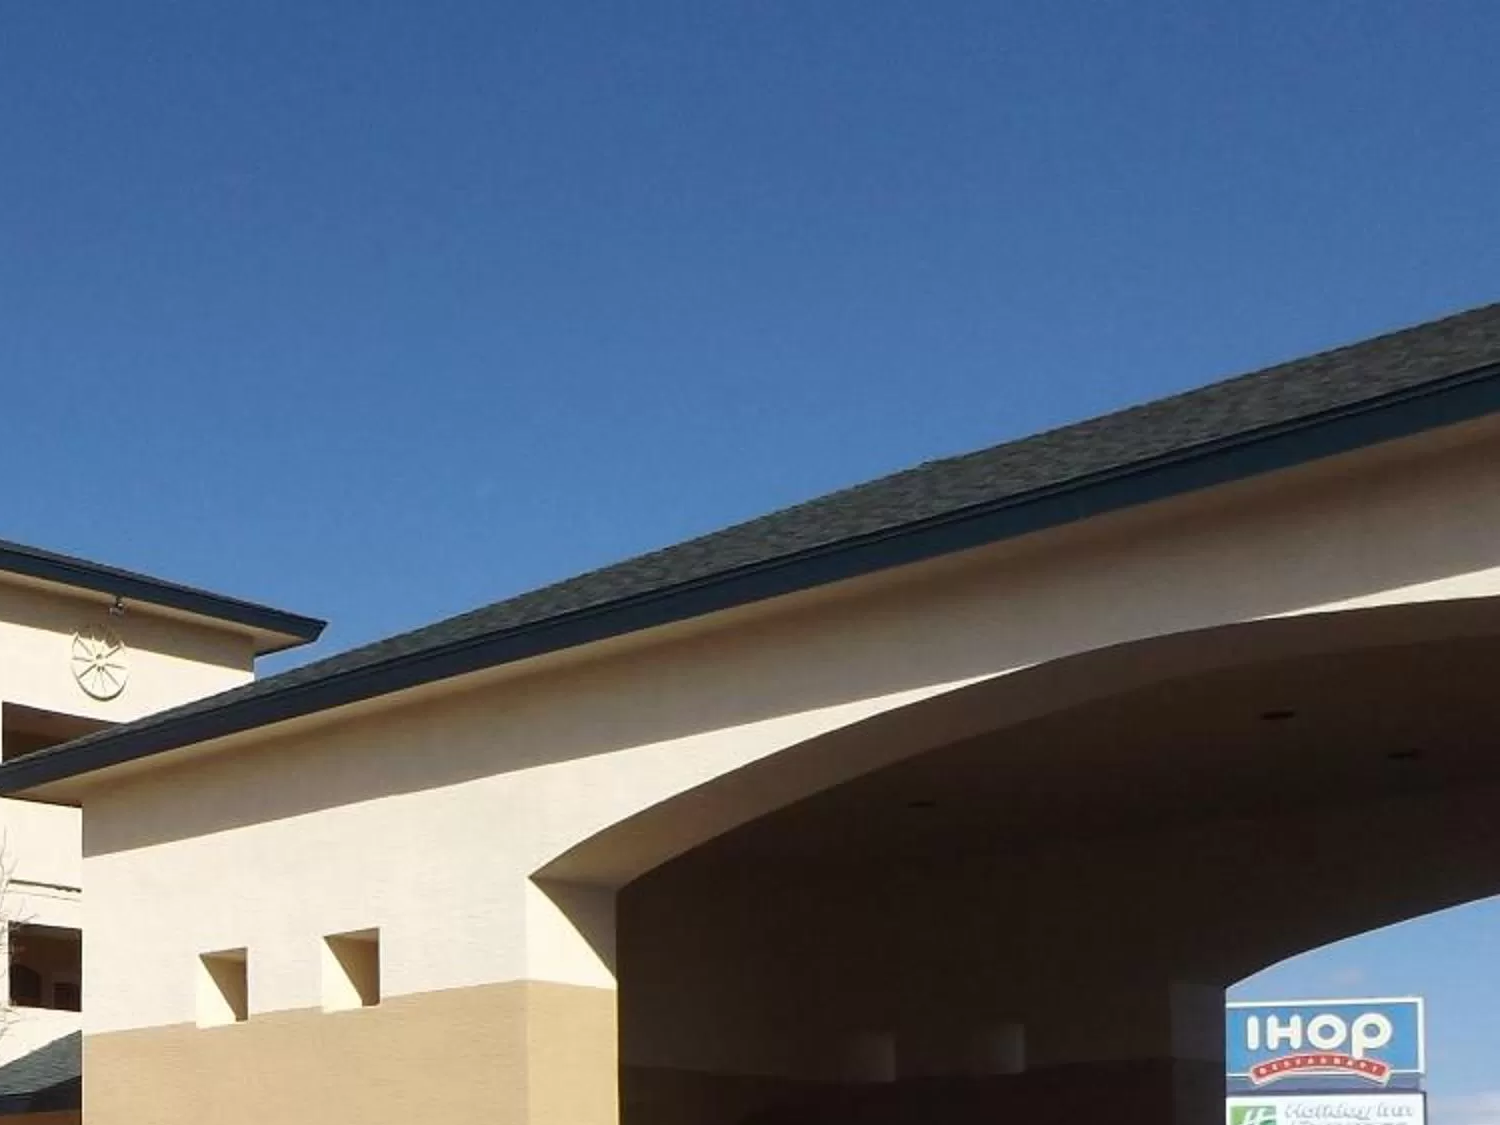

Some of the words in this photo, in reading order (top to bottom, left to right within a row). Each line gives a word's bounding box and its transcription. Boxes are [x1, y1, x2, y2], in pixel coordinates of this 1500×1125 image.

[1247, 1012, 1392, 1058] IHOP
[1284, 1102, 1371, 1120] Holiday
[1375, 1103, 1414, 1118] Inn
